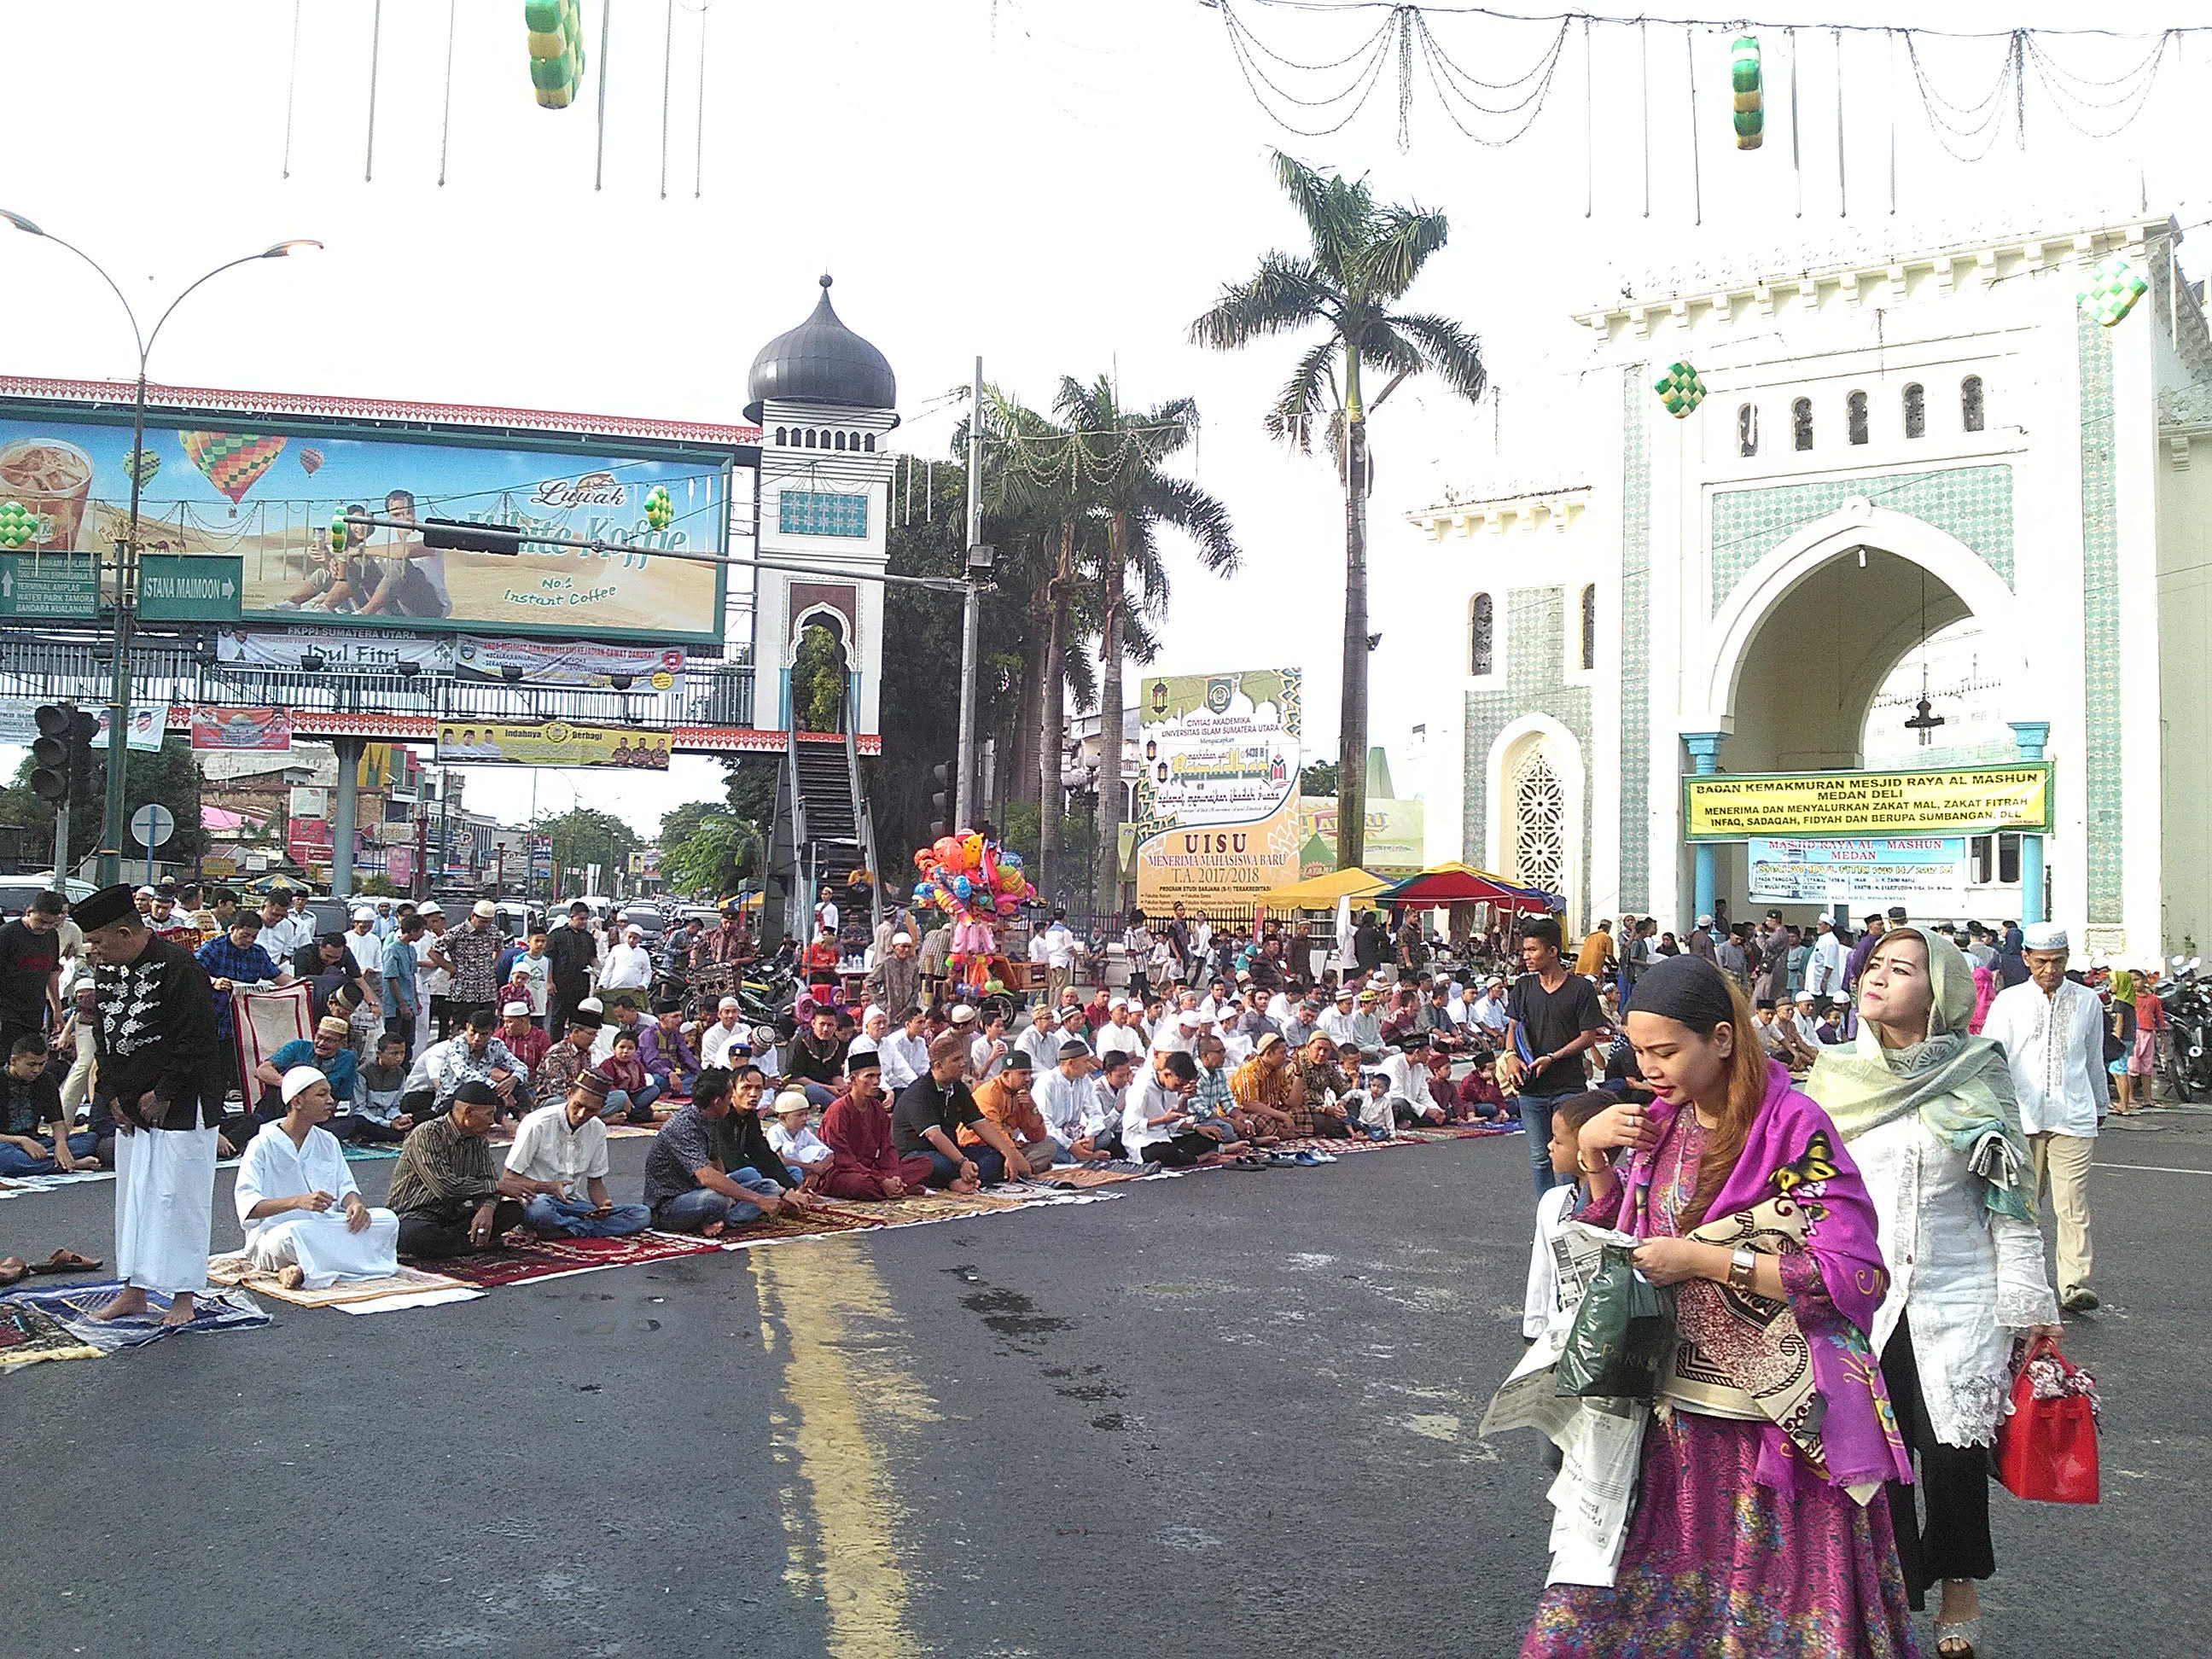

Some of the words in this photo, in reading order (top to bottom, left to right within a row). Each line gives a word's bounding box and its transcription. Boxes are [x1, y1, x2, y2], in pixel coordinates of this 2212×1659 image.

[530, 480, 626, 507] Luwak
[17, 582, 49, 591] TERMINAL
[53, 583, 80, 592] AMPLAS
[144, 578, 174, 598] ISTANA
[177, 579, 220, 599] MAIMOON
[542, 577, 573, 589] No.1
[17, 593, 42, 602] WATER
[43, 594, 63, 602] PARK
[65, 595, 95, 603] TAMORA
[504, 589, 564, 606] Instant
[569, 585, 616, 604] Coffee
[16, 603, 49, 613] BANDARA
[288, 626, 318, 636] FKPPI
[322, 628, 378, 639] SUMATERA
[381, 631, 416, 640] UTARA
[355, 645, 399, 664] Fitri
[1186, 719, 1211, 727] CIVITAS
[1213, 717, 1251, 725] AKADEMIKA
[504, 729, 542, 739] Indahnya
[572, 731, 603, 742] Berbagi
[1161, 728, 1200, 737] UNIVERSITAS
[1202, 726, 1221, 735] ISLAM
[1223, 725, 1256, 734] SUMATERA
[1259, 724, 1279, 732] UTARA
[1697, 784, 1741, 795] BADAN
[1745, 780, 1845, 793] KEMAKMURAN
[1849, 778, 1902, 789] MESJID
[1906, 777, 1944, 787] RAYA
[1948, 777, 1967, 785] AL
[1972, 773, 2037, 784] MASHUN
[1818, 790, 1866, 800] MEDAN
[1871, 789, 1903, 799] DELI
[1704, 806, 1760, 816] MENERIMA
[1762, 806, 1784, 814] DAN
[1787, 803, 1870, 813] MENYALURKAN
[1872, 801, 1910, 811] ZAKAT
[1913, 800, 1941, 810] MAL,
[1944, 800, 1982, 808] ZAKAT
[1985, 798, 2029, 807] FITRAH
[1711, 818, 1744, 828] INFAQ,
[1747, 817, 1800, 826] SADAQAH,
[1803, 816, 1842, 824] FIDYAH
[1845, 815, 1867, 824] DAN
[1871, 813, 1916, 824] BERUPA
[2000, 811, 2022, 819] DLL
[1185, 833, 1247, 853] UISU
[1769, 841, 1815, 849] MASJID
[1820, 841, 1853, 849] RAYA
[1858, 841, 1874, 849] AL
[1887, 841, 1942, 849] MASHUN
[1148, 855, 1198, 867] MENERIMA
[1201, 854, 1257, 866] MAHASISWA
[1260, 853, 1287, 866] BARU
[1831, 851, 1876, 860] MEDAN
[1172, 868, 1195, 883] T.A.
[1198, 867, 1260, 883] 2017/2018
